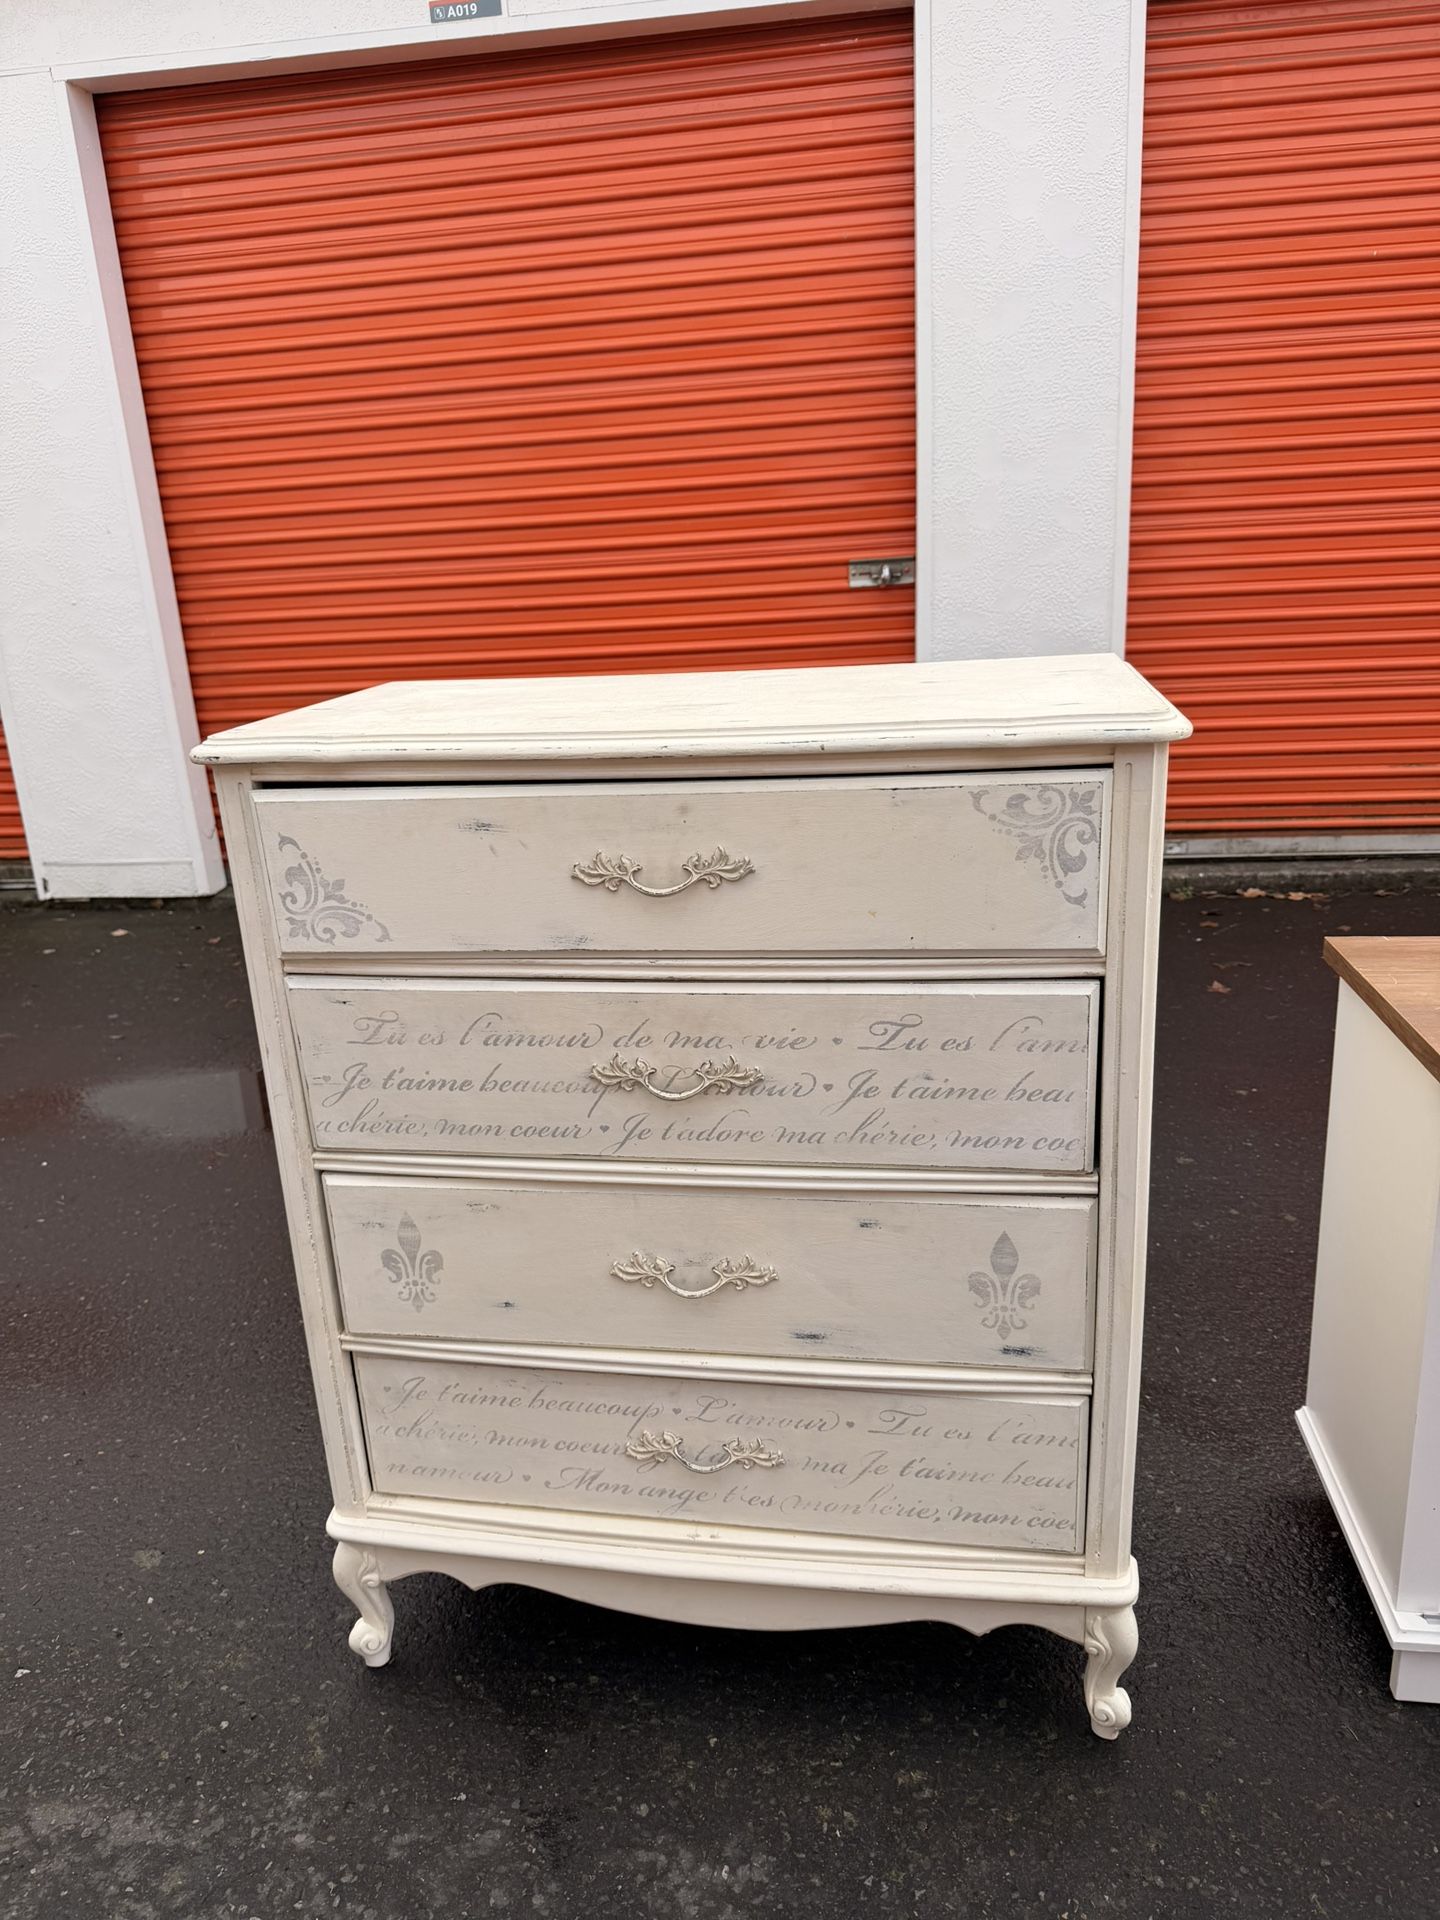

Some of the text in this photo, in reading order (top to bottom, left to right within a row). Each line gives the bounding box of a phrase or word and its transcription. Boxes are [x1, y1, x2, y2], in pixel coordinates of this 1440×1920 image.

[447, 3, 478, 18] A019
[348, 1010, 405, 1046] Tu
[418, 1030, 448, 1047] es
[460, 1012, 603, 1048] l'amour
[613, 1018, 652, 1049] de
[743, 1028, 818, 1050] vie
[857, 1013, 929, 1052] Tu
[940, 1035, 974, 1052] es
[322, 1062, 371, 1108] Je
[382, 1065, 473, 1093] t'aime
[821, 1068, 881, 1116] Je
[434, 1118, 503, 1138] mon
[510, 1122, 592, 1141] coeur
[600, 1112, 652, 1154] Je
[661, 1109, 765, 1143] t'adore
[772, 1124, 826, 1145] ma
[946, 1129, 1027, 1151] mon
[377, 1376, 428, 1416] Je
[438, 1383, 522, 1408] t'aime
[527, 1385, 664, 1437] beaucoup
[685, 1395, 840, 1432] L'amour
[868, 1407, 931, 1438] Tu
[943, 1427, 972, 1441] es
[484, 1429, 550, 1449] mon
[801, 1456, 847, 1475] ma
[835, 1450, 888, 1488] Je
[544, 1466, 634, 1496] Mon
[638, 1485, 716, 1516] ange
[947, 1506, 1022, 1526] mon
